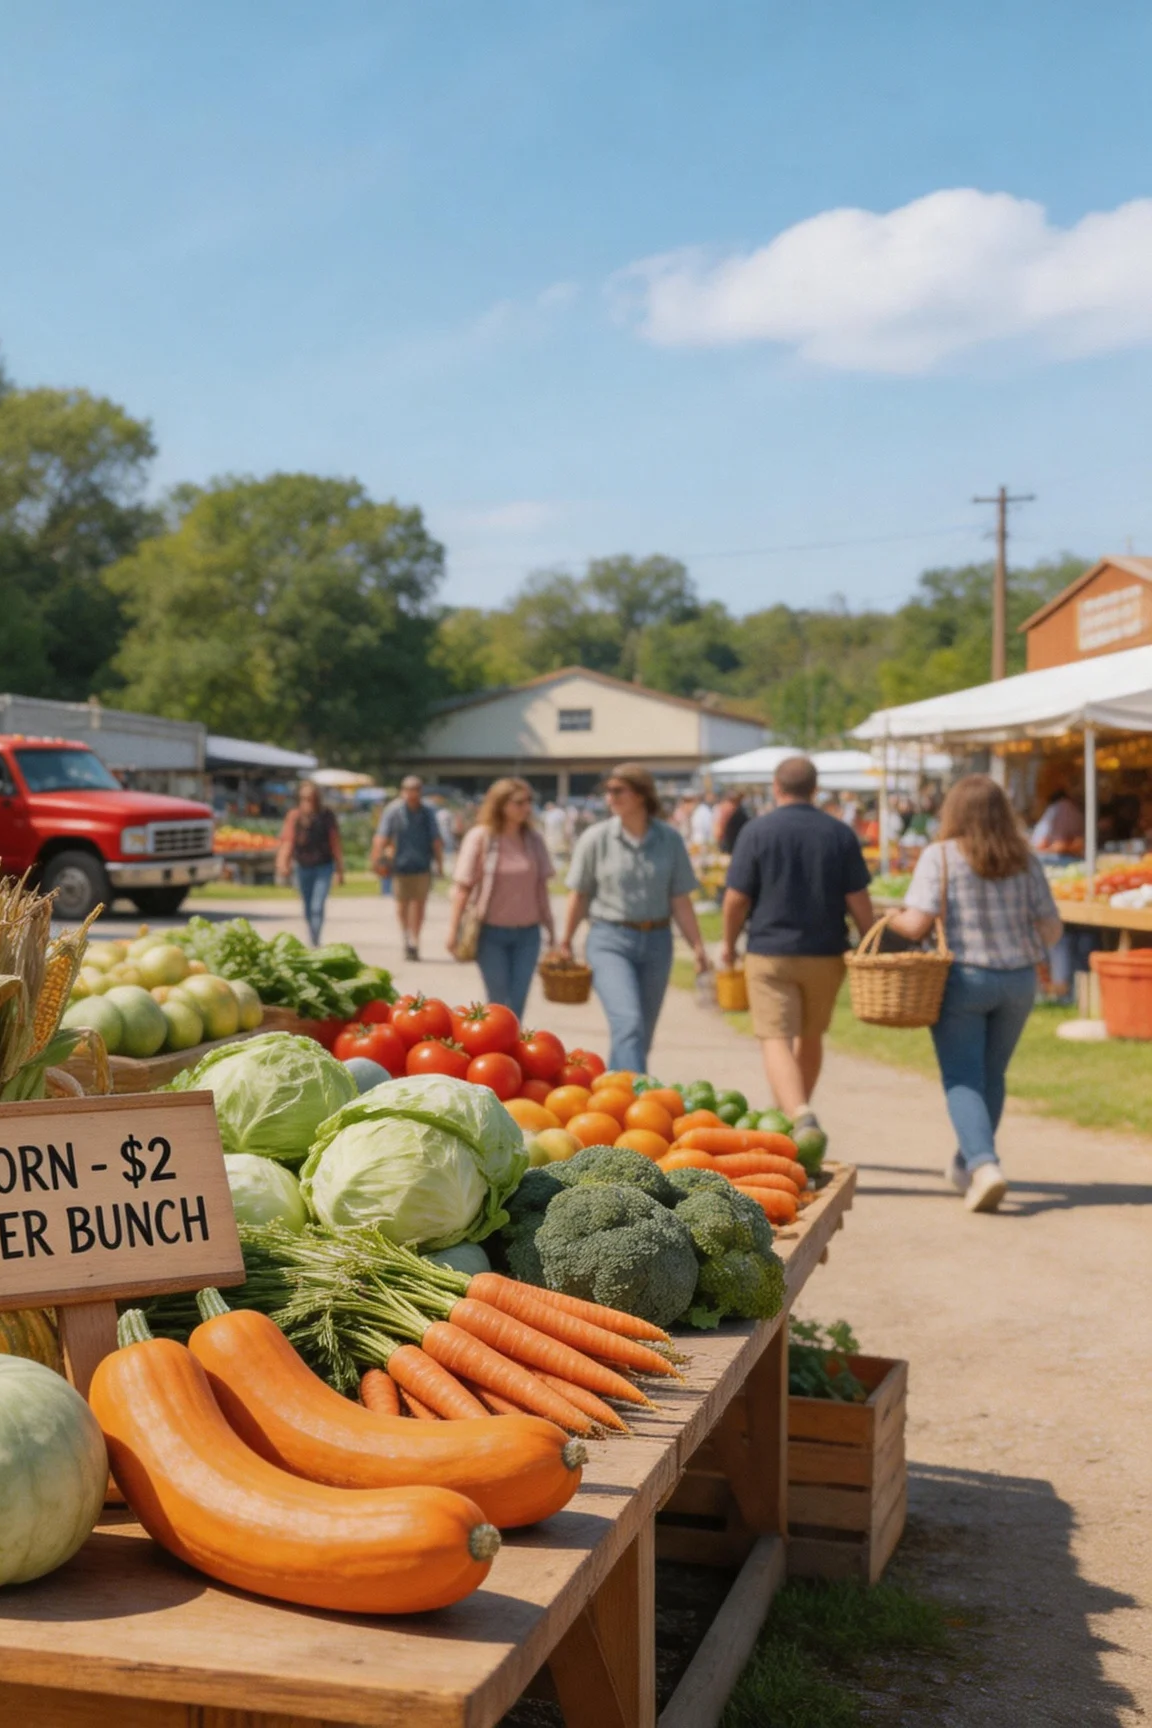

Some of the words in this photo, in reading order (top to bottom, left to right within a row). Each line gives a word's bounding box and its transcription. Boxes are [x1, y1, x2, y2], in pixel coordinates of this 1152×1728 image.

[90, 1162, 108, 1172] -
[120, 1133, 177, 1189] $2
[66, 1195, 210, 1254] BUNCH
